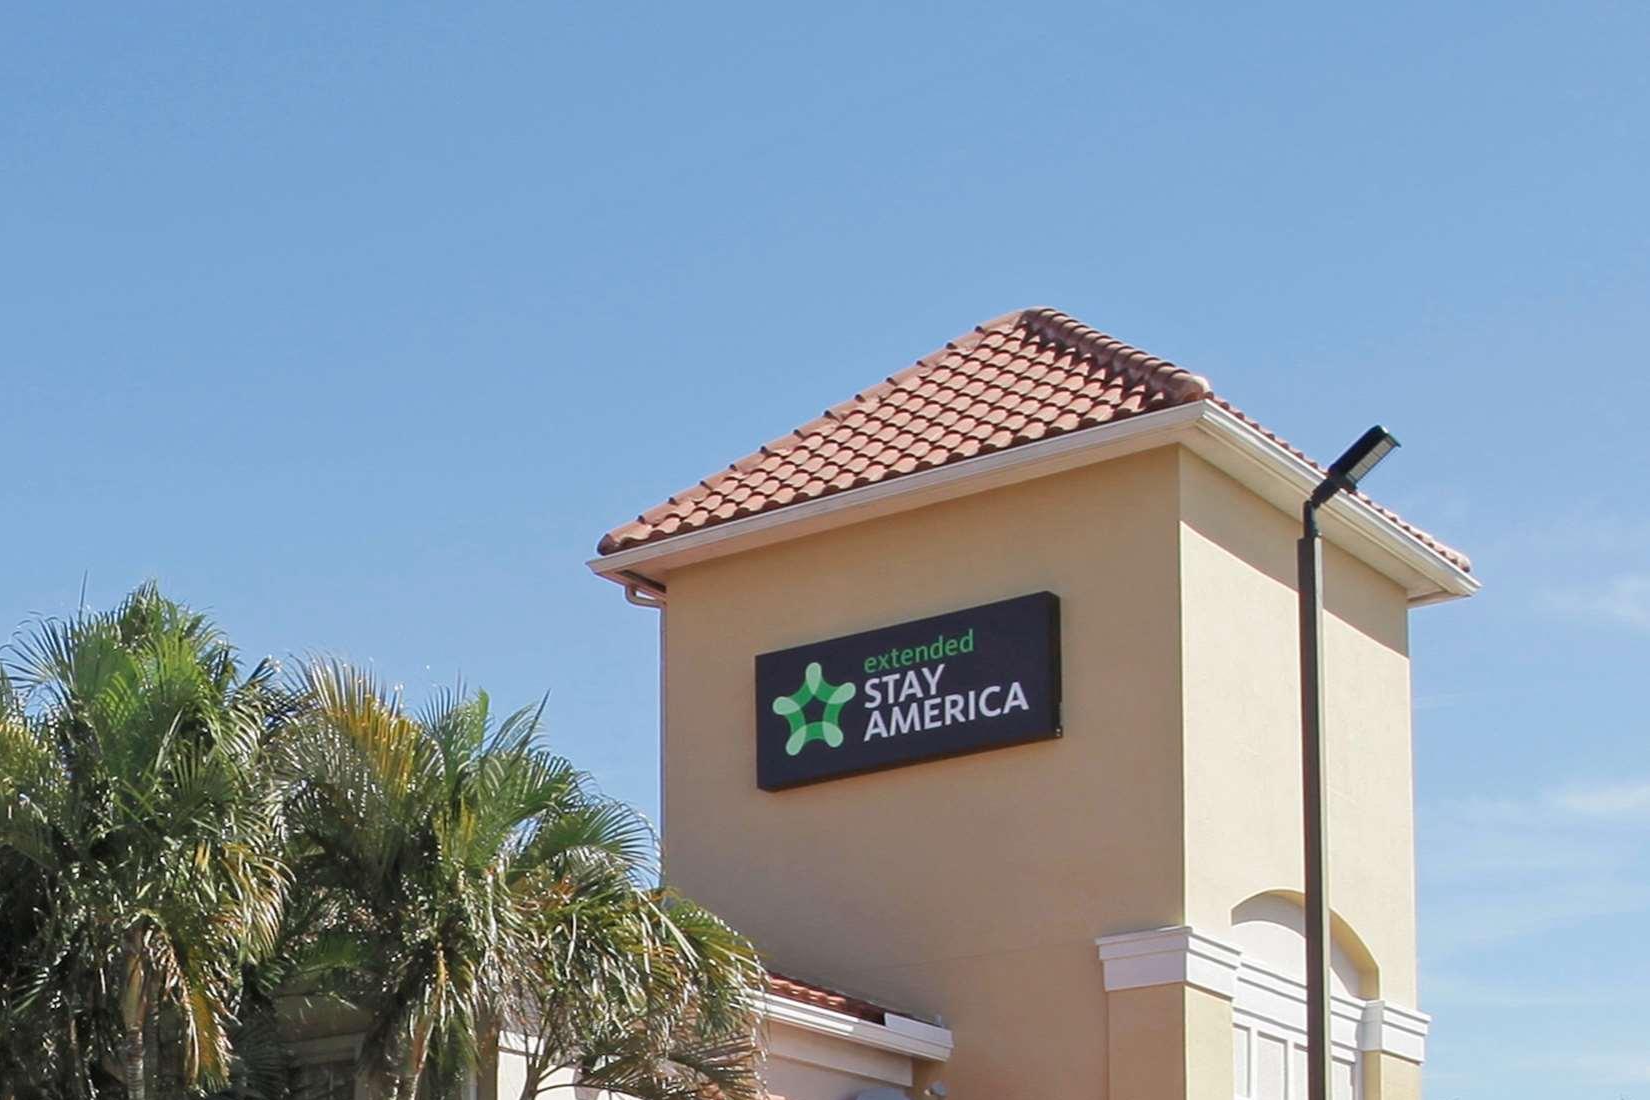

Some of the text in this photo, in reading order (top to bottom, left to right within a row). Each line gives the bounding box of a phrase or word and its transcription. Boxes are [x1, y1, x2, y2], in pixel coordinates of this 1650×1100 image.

[864, 628, 975, 673] extended
[864, 663, 946, 709] STAY
[863, 681, 1030, 742] AMERICA
